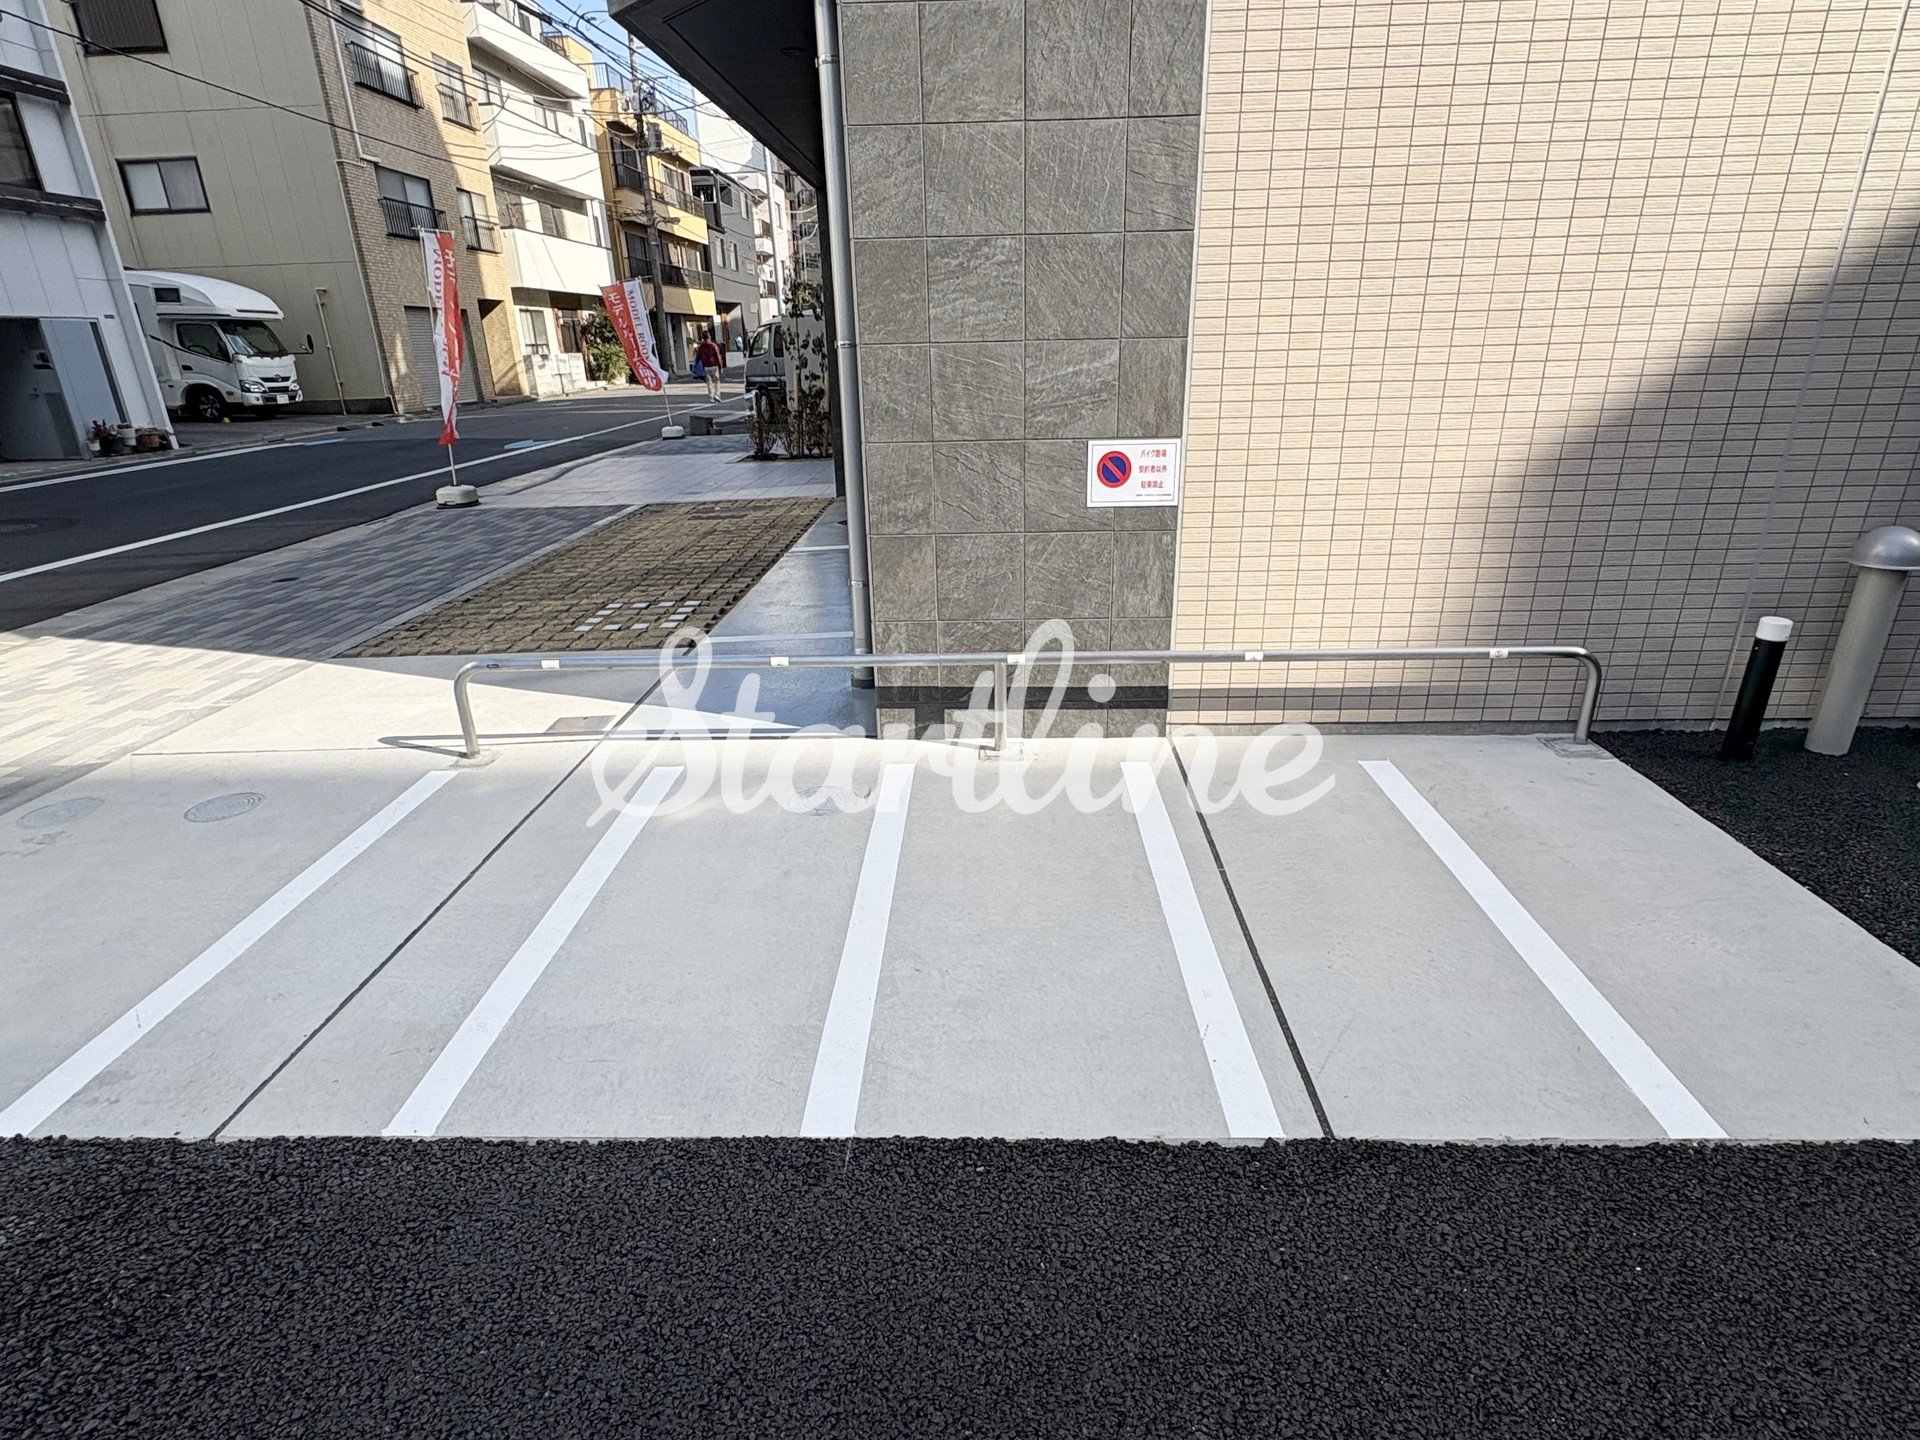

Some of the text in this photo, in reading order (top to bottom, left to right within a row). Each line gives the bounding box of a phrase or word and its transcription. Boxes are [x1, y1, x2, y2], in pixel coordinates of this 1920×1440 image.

[626, 289, 643, 330] MODEL
[1138, 465, 1168, 474] 契約者以外
[1140, 480, 1164, 489] 駐車禁止
